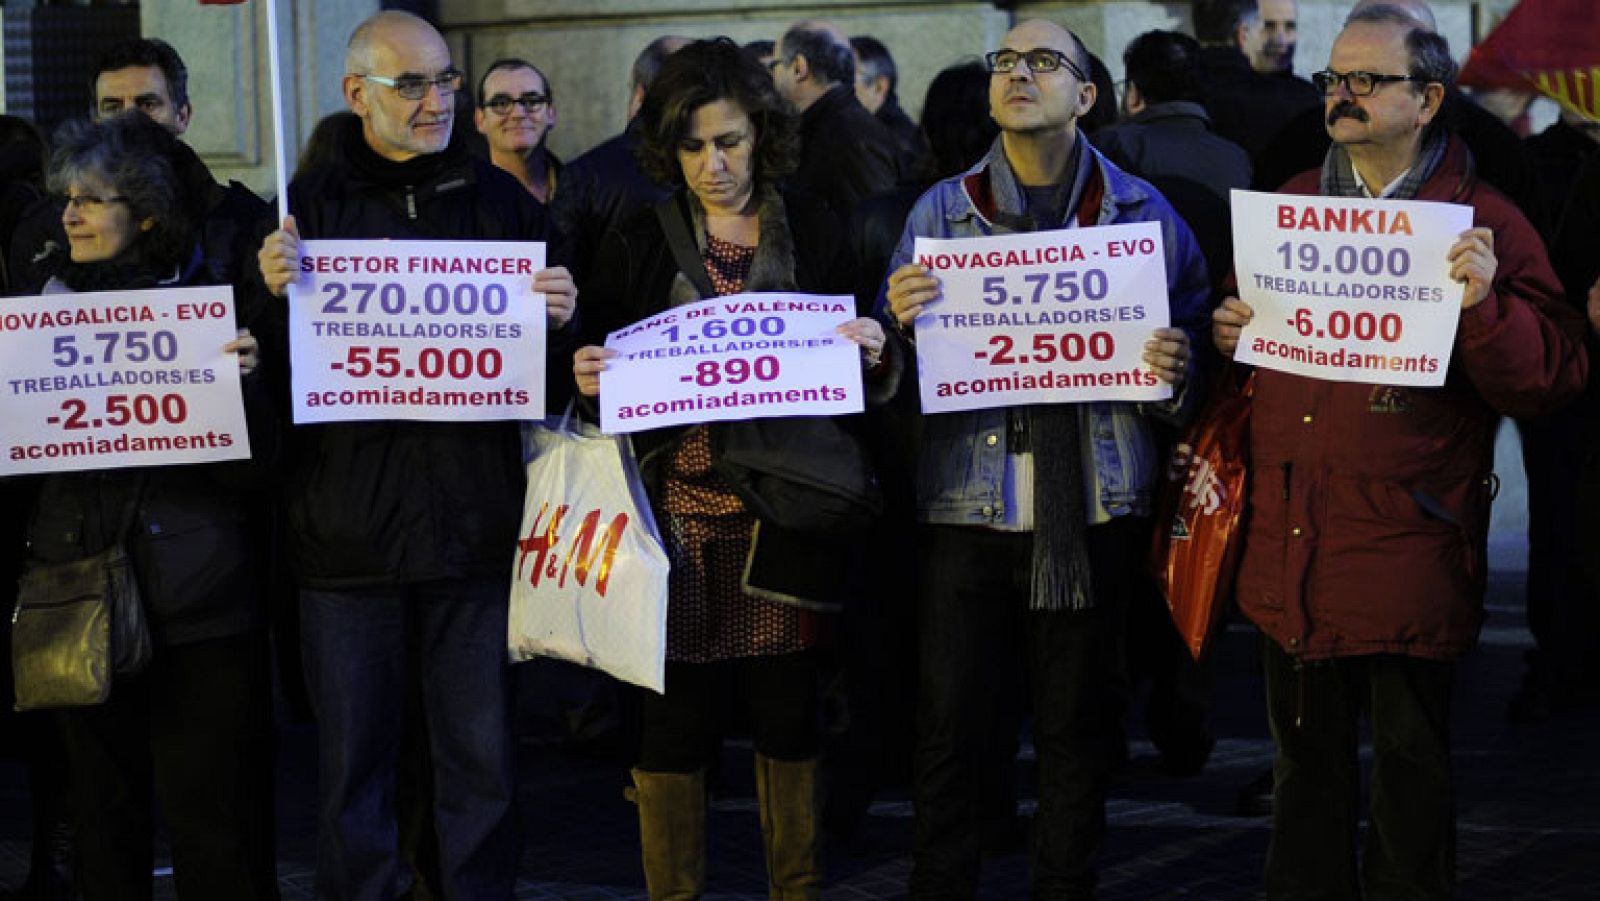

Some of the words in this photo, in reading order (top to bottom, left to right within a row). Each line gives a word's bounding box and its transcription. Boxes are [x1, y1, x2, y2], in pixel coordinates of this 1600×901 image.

[1276, 204, 1413, 236] BANKIA
[301, 256, 399, 274] SECTOR
[408, 257, 532, 275] FINANCER
[919, 244, 1086, 270] NOVAGALICIA
[1107, 237, 1155, 258] EVO
[1276, 241, 1412, 277] 19.000
[321, 281, 508, 316] 270.000
[982, 268, 1109, 306] 5.750
[1253, 273, 1444, 302] TREBALLADORS/ES
[0, 305, 155, 331] OVAGALICIA
[176, 302, 227, 320] EVO
[686, 306, 717, 319] DE
[939, 305, 1146, 328] TREBALLADORS/ES
[1286, 308, 1403, 342] -6.000
[312, 321, 522, 339] TREBALLADORS/ES
[661, 316, 786, 342] 1.600
[53, 330, 178, 368] 5.750
[330, 345, 503, 380] -55.000
[974, 331, 1116, 366] -2.500
[1251, 337, 1439, 374] acomiadaments
[8, 368, 216, 394] TREBALLADORS/ES
[679, 355, 780, 387] -890
[936, 367, 1158, 397] acomiadaments
[46, 393, 188, 430] -2.500
[306, 385, 530, 407] acomiadaments
[617, 384, 847, 420] acomiadaments
[10, 431, 234, 461] acomiadaments
[519, 501, 629, 597] H&M
